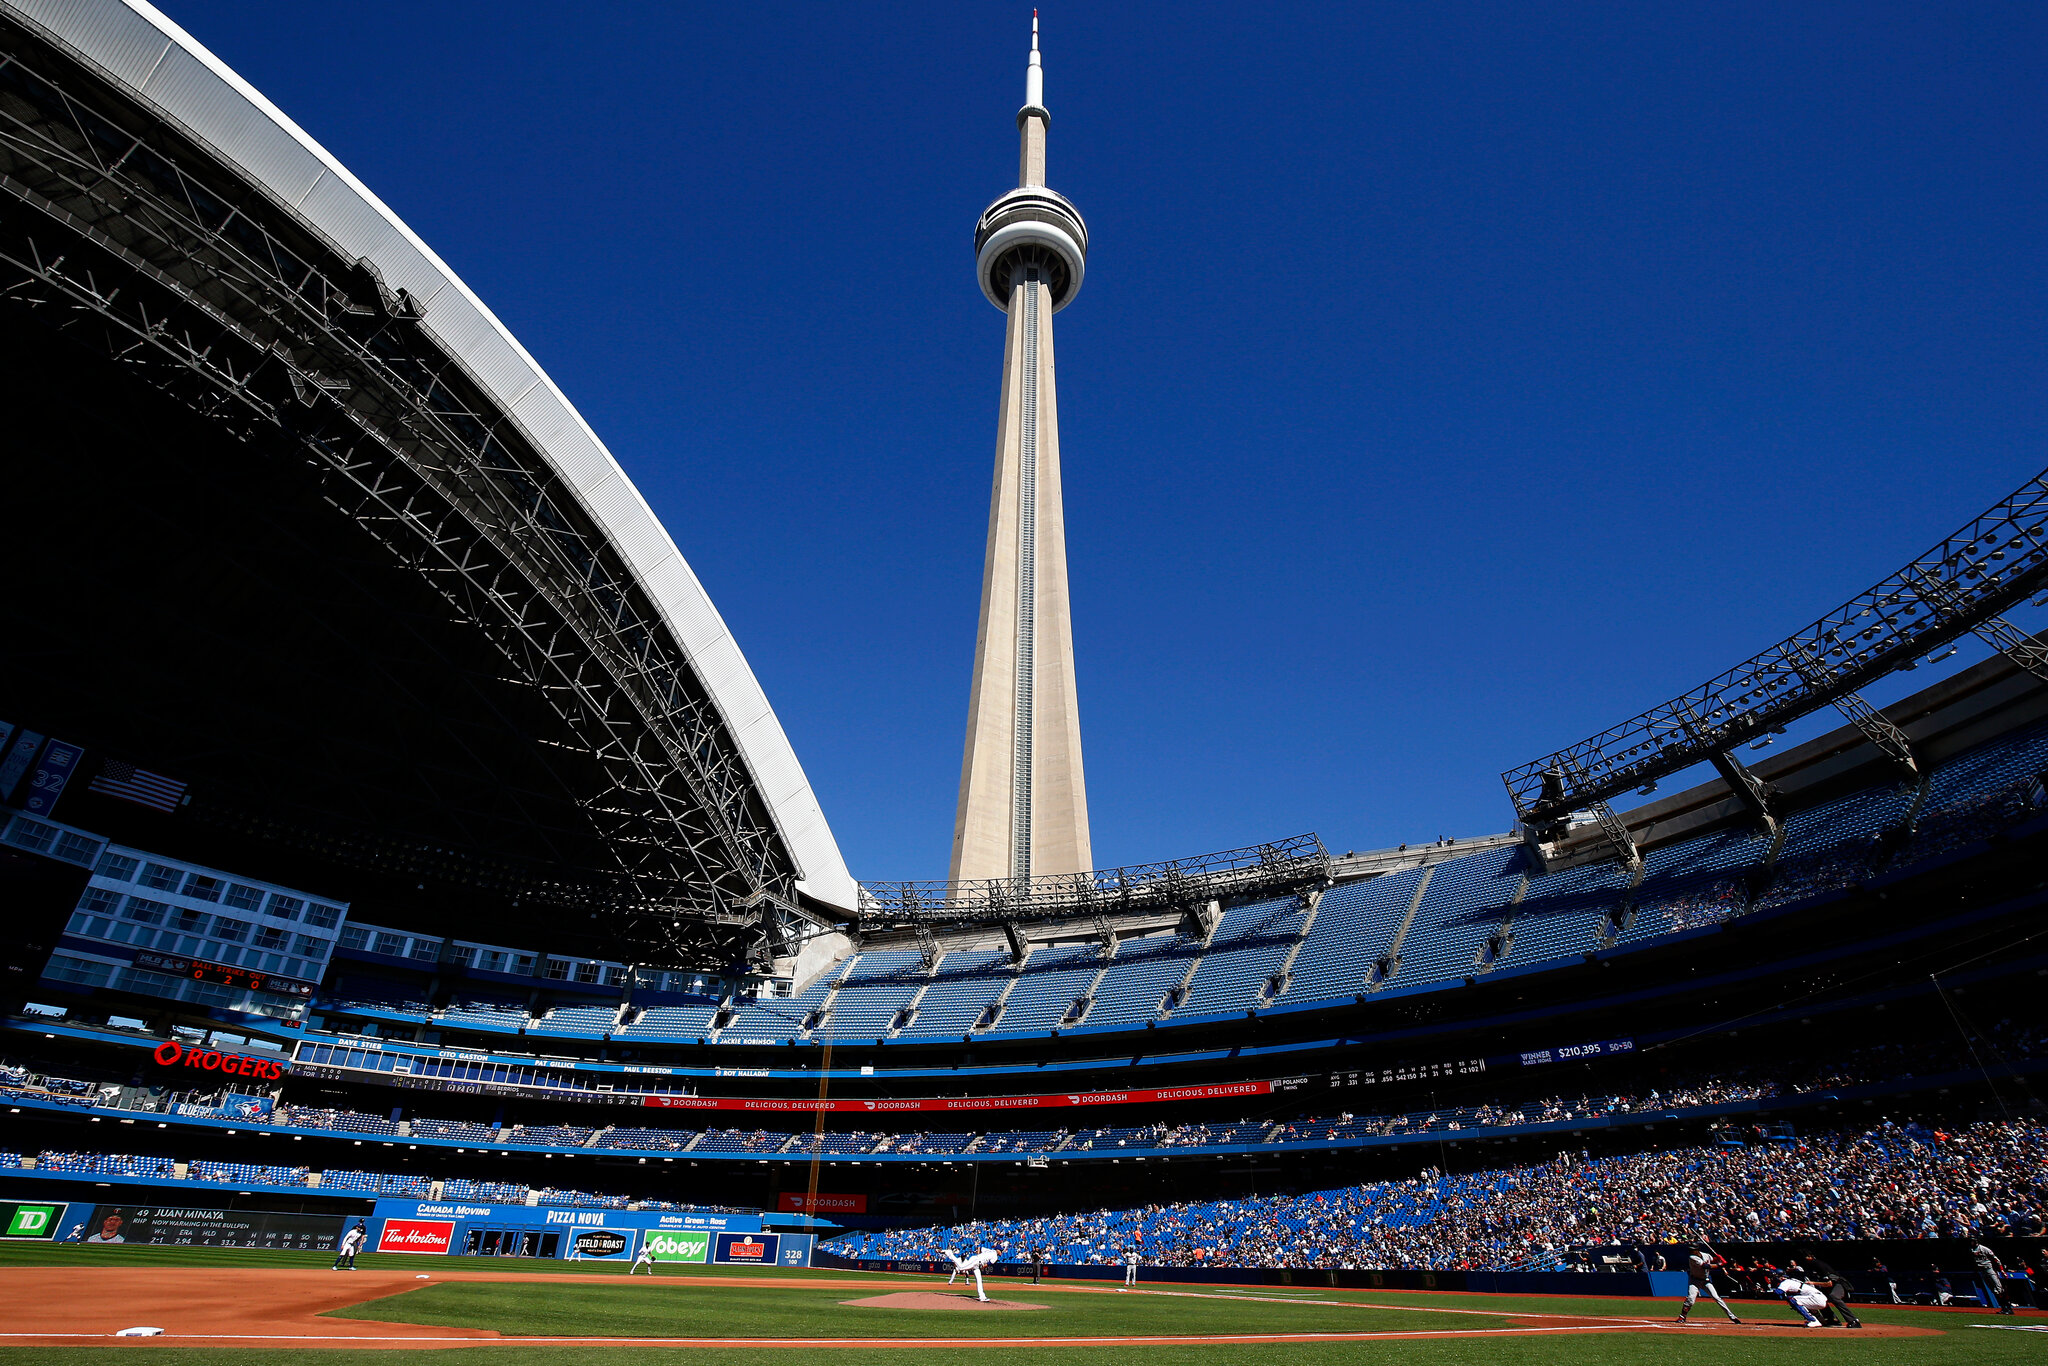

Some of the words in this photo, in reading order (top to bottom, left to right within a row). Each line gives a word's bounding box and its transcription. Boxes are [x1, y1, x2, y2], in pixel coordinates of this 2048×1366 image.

[32, 769, 63, 792] 32
[192, 960, 213, 971] BALL
[216, 966, 246, 976] STRIKE
[249, 972, 267, 981] OUT
[194, 969, 203, 979] 0
[224, 976, 232, 985] 2
[251, 980, 259, 990] 0
[339, 1038, 358, 1047] DAVE
[1521, 1050, 1551, 1060] WINNER
[1559, 1044, 1601, 1058] $210,395
[184, 1048, 283, 1081] ROGERS
[1082, 1094, 1128, 1102] DOORDASH
[1157, 1088, 1203, 1099] DELICIOUS,
[1207, 1085, 1256, 1095] DELIVERED
[417, 1203, 453, 1214] CANADA
[455, 1206, 490, 1216] MOVING
[806, 1198, 856, 1207] DOORDASH
[19, 1211, 47, 1229] TD
[154, 1209, 183, 1219] JUAN
[184, 1210, 224, 1220] MINAYA
[546, 1210, 576, 1224] PIZZA
[578, 1212, 605, 1226] NOVA
[386, 1229, 404, 1242] Tim
[405, 1229, 447, 1245] Hortons
[578, 1239, 598, 1248] FIELD
[602, 1240, 624, 1248] ROAST
[650, 1236, 705, 1257] Sobeys
[785, 1250, 802, 1259] 328
[898, 1262, 921, 1271] Timberline
